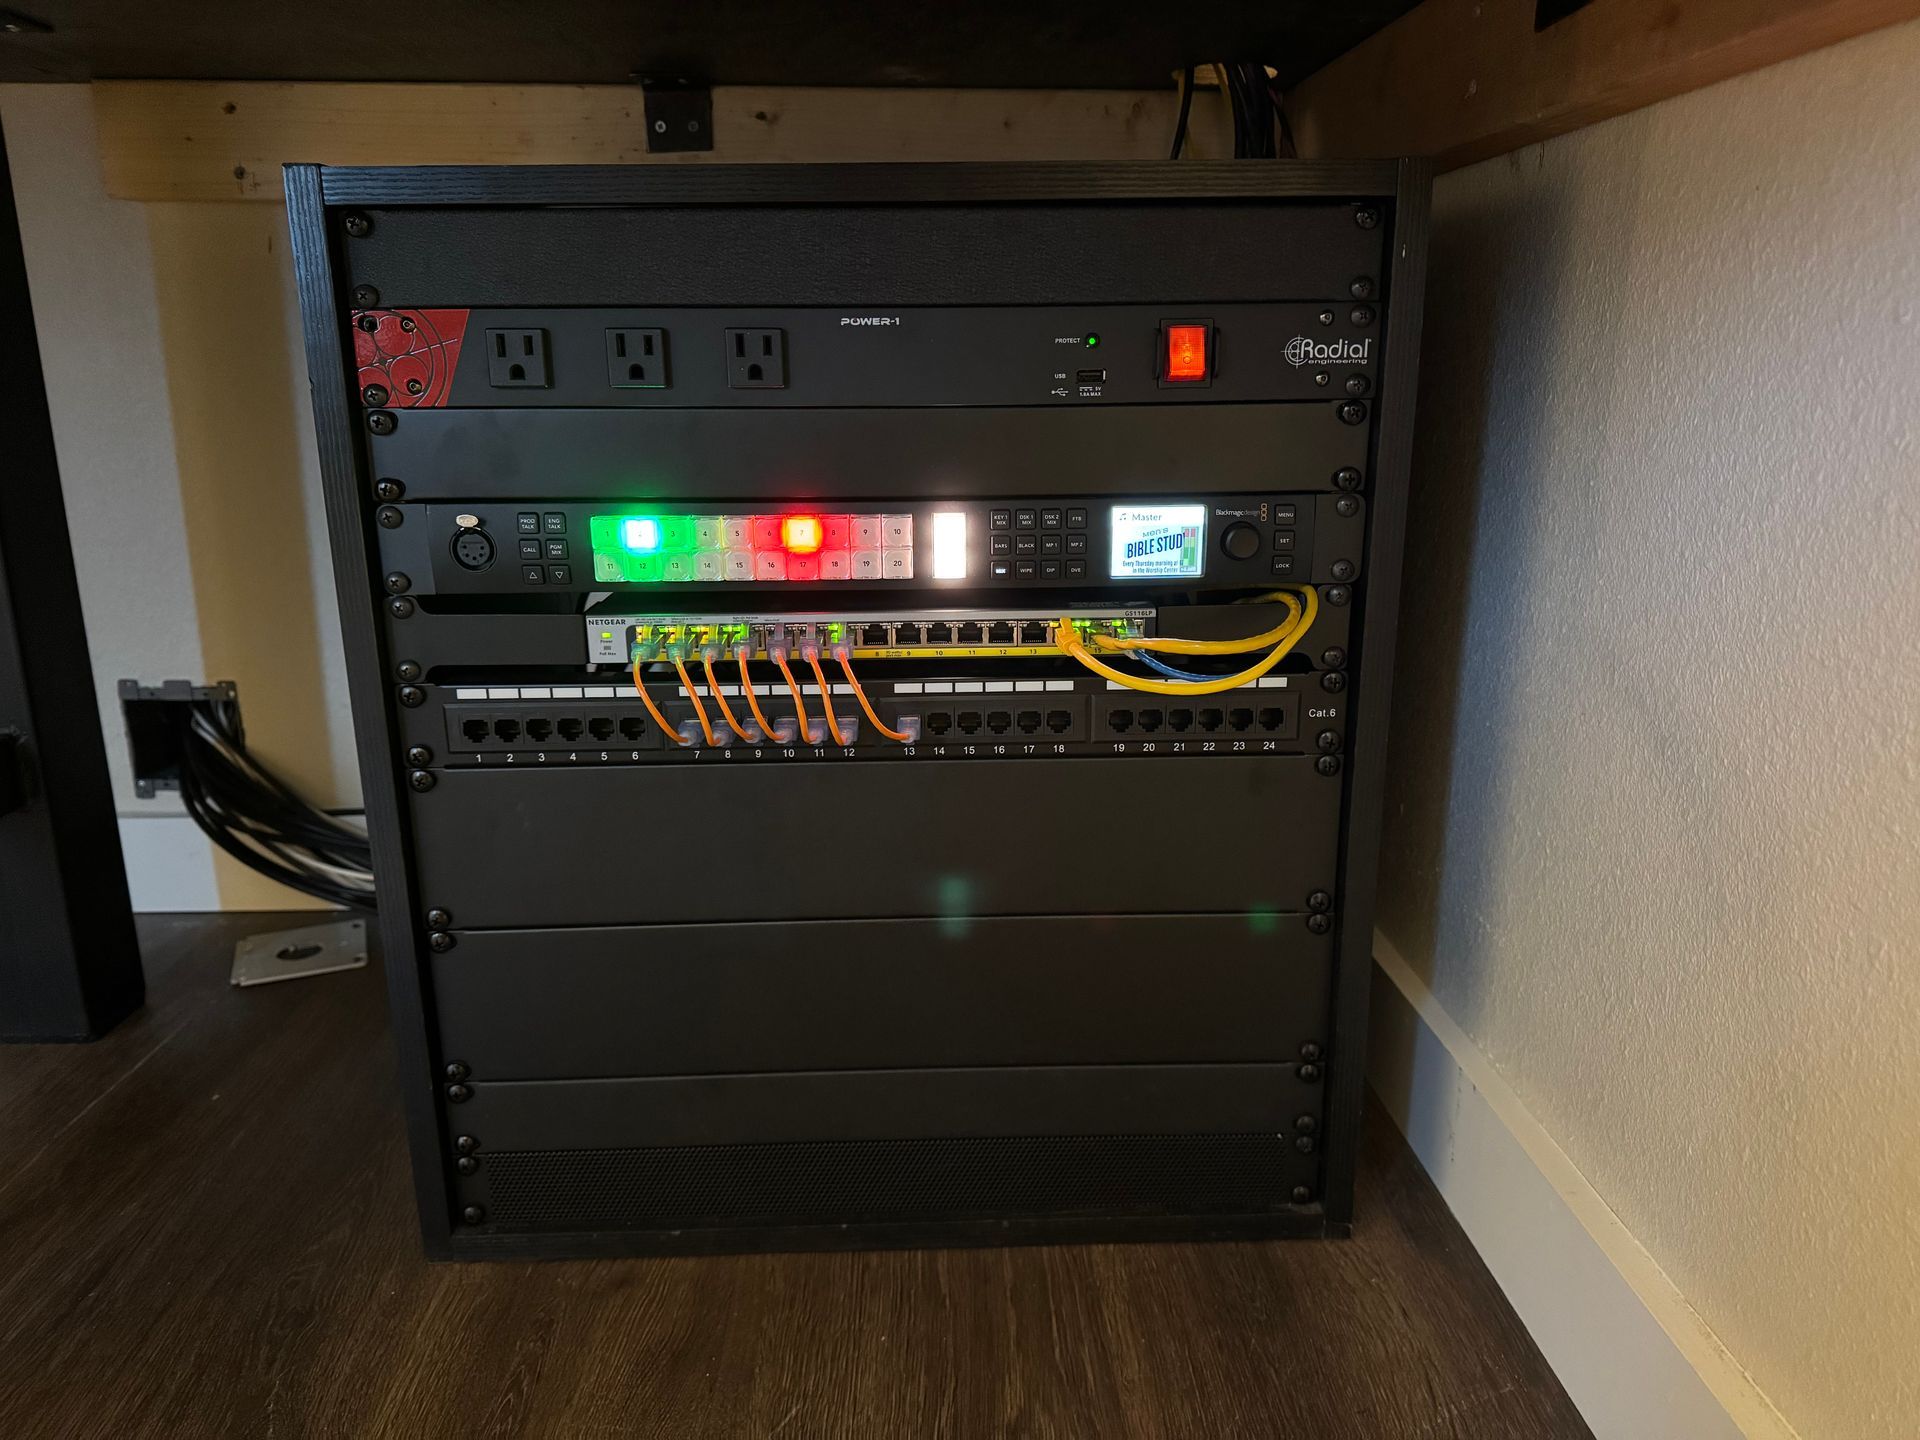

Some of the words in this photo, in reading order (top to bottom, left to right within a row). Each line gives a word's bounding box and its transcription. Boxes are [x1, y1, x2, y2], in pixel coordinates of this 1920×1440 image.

[841, 317, 900, 326] POWER-1
[1300, 338, 1369, 358] Radial
[1127, 538, 1154, 558] BIBLE
[1308, 708, 1336, 718] Cat.6
[904, 747, 915, 756] 13
[934, 747, 945, 755] 14
[964, 746, 975, 754] 15
[994, 746, 1005, 754] 16
[1024, 745, 1034, 753] 17
[1053, 745, 1064, 753] 18
[1113, 744, 1125, 752] 19
[1143, 743, 1155, 752] 20
[1174, 743, 1185, 751] 21
[1203, 742, 1215, 751] 22
[1233, 742, 1245, 750] 23
[1263, 741, 1275, 750] 24
[783, 749, 794, 757] 10
